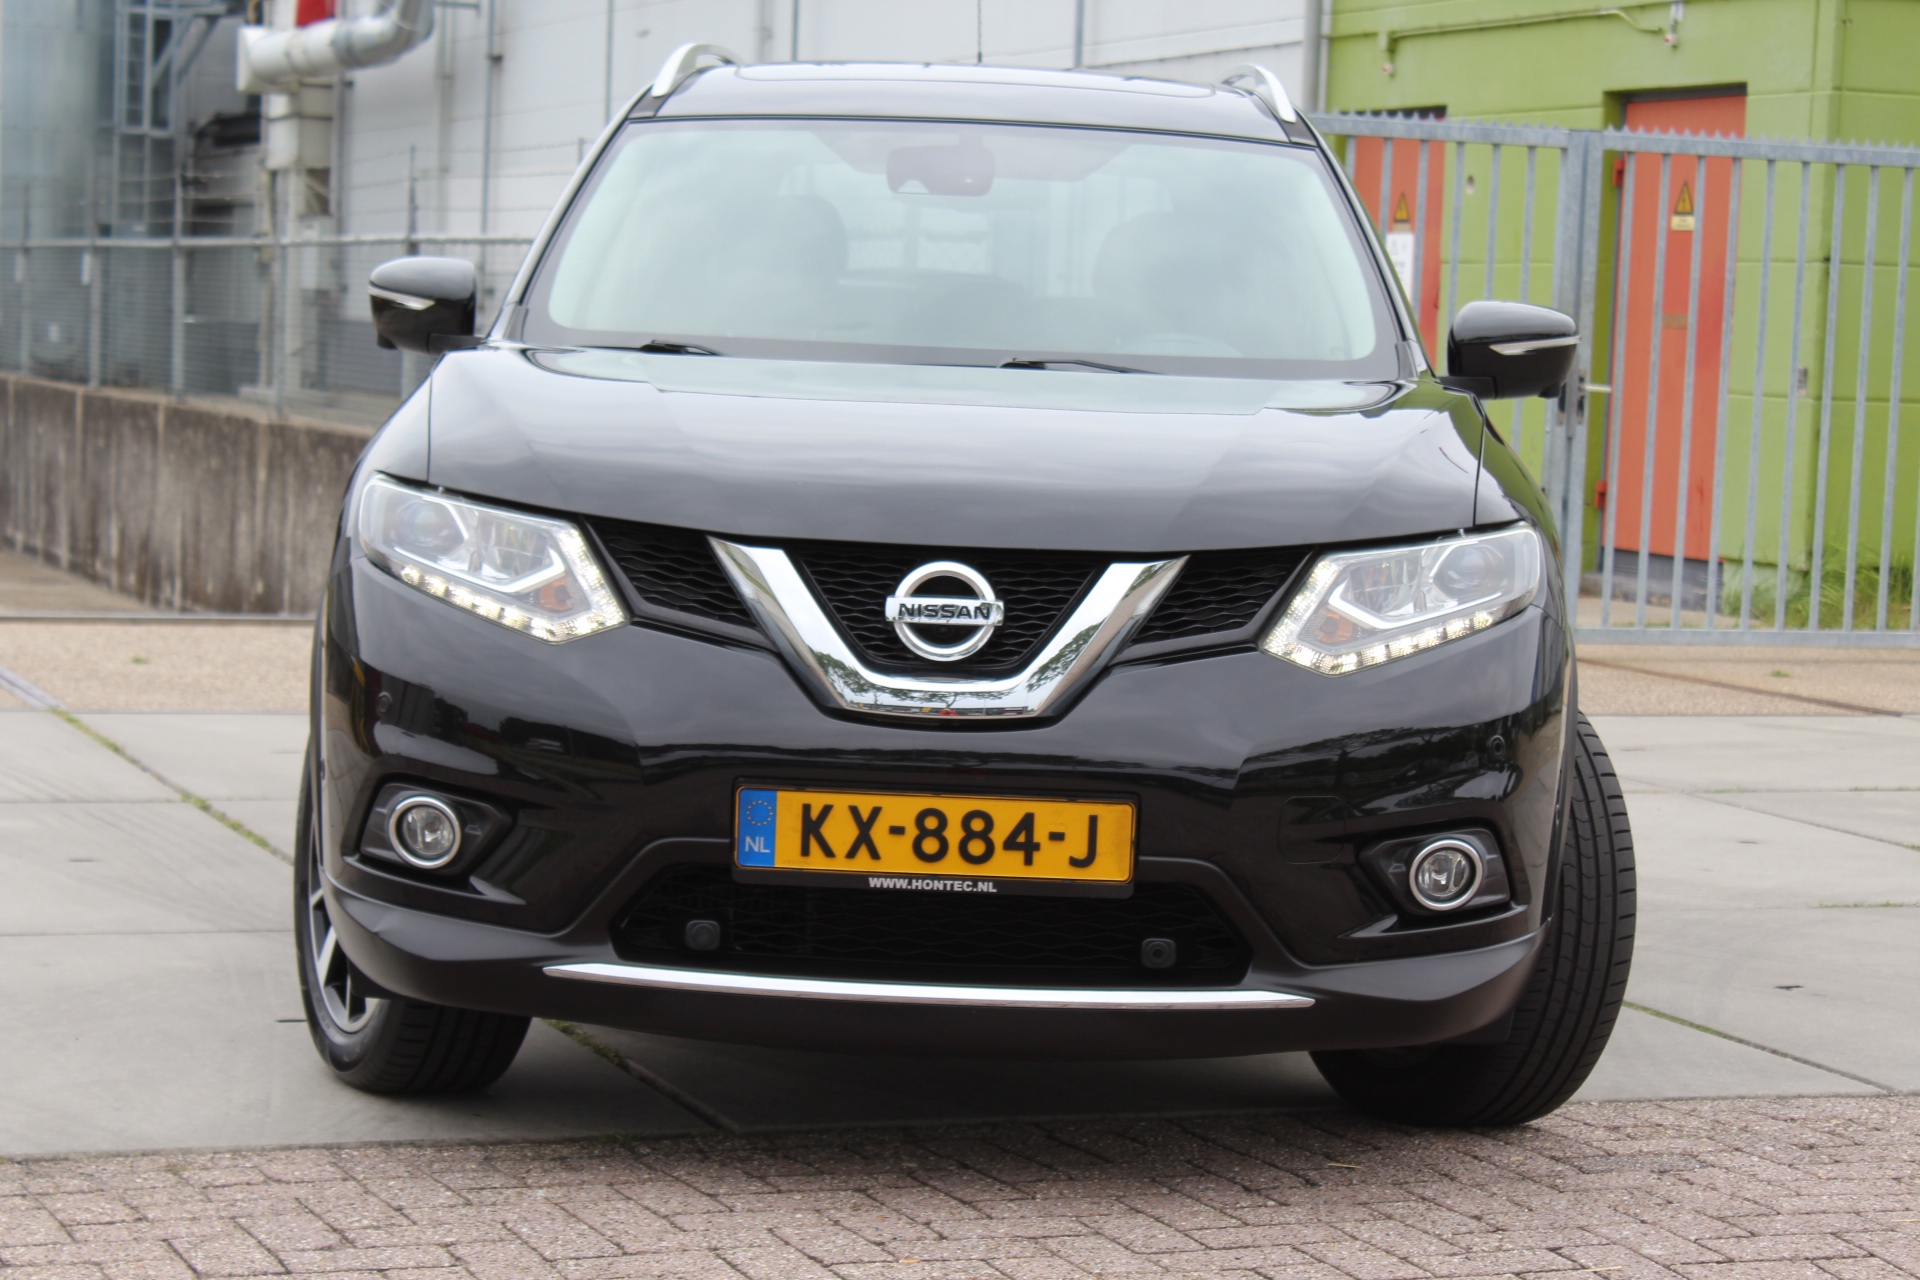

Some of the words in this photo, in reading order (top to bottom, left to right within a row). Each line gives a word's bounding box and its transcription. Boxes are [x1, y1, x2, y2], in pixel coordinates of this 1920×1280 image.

[898, 603, 991, 620] NISSAN
[745, 836, 771, 853] NL
[800, 803, 1098, 869] KX-884-J
[869, 877, 997, 893] WWW.HONTEC.NL
